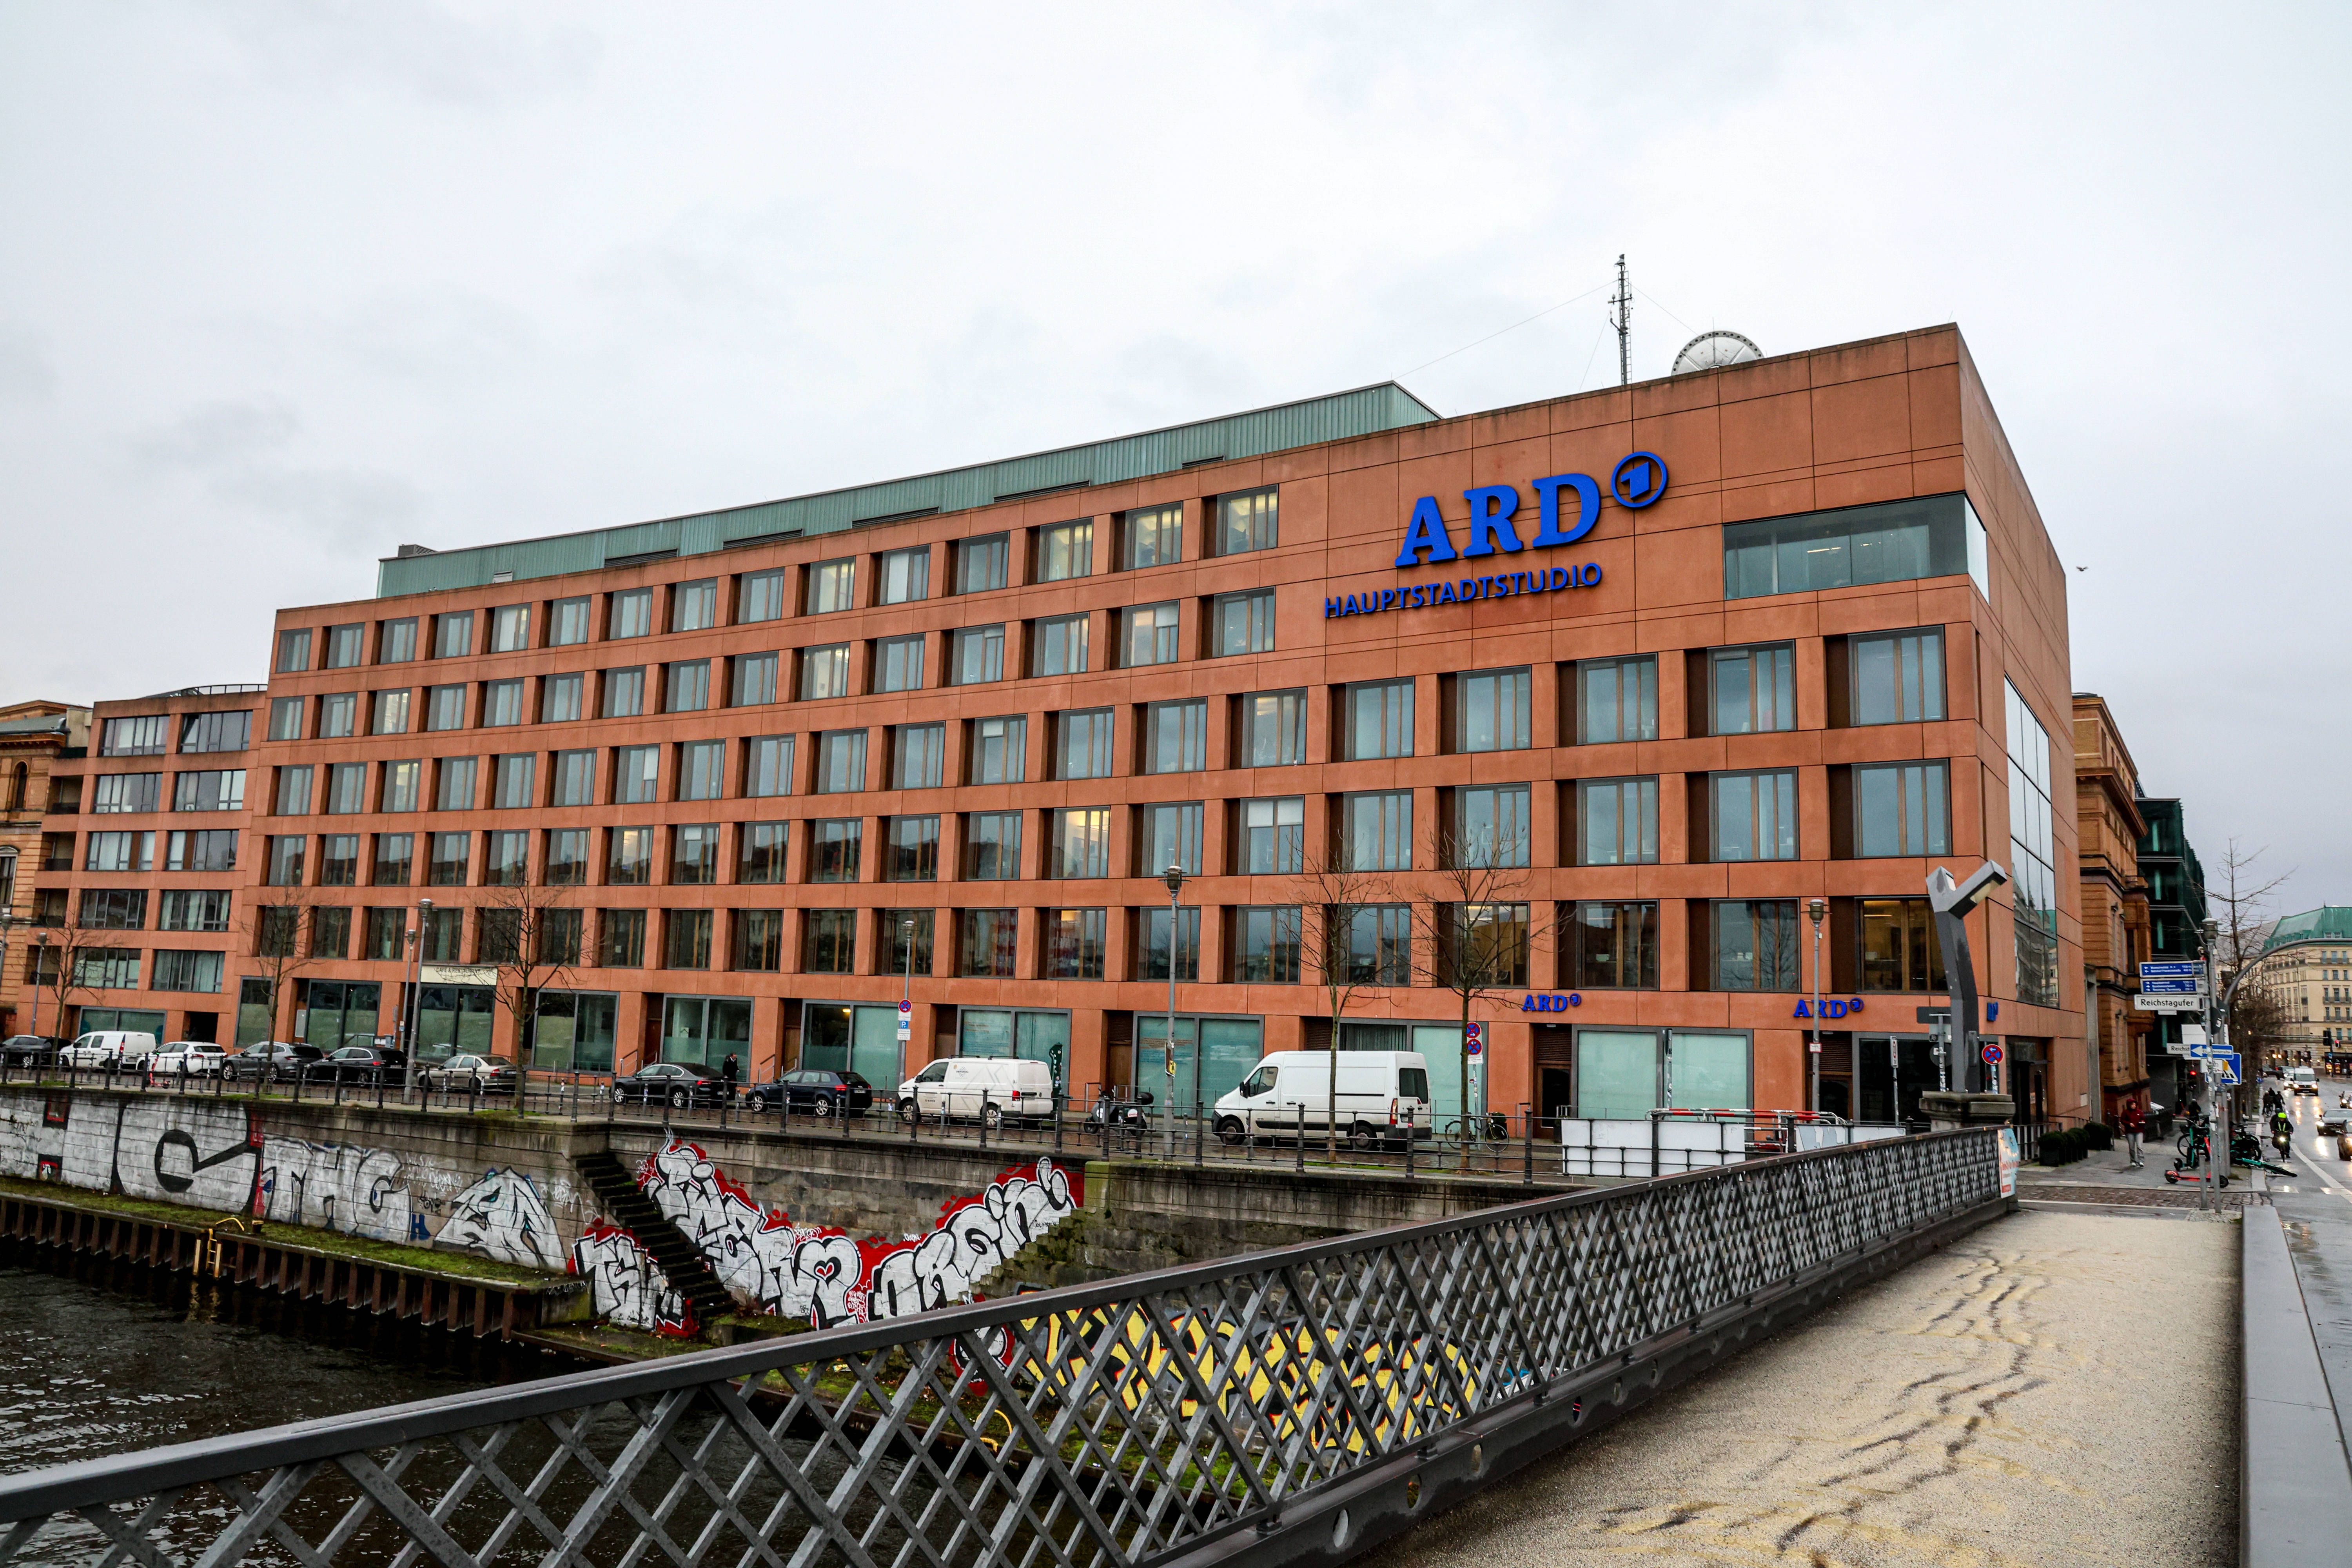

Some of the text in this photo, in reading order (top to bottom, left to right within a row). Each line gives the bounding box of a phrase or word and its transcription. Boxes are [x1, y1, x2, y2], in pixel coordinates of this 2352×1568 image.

[1395, 473, 1601, 567] ARD
[1325, 563, 1602, 618] HAUPTSTADTSTUDIO
[1522, 995, 1568, 1011] ARD
[1793, 1000, 1847, 1018] ARD
